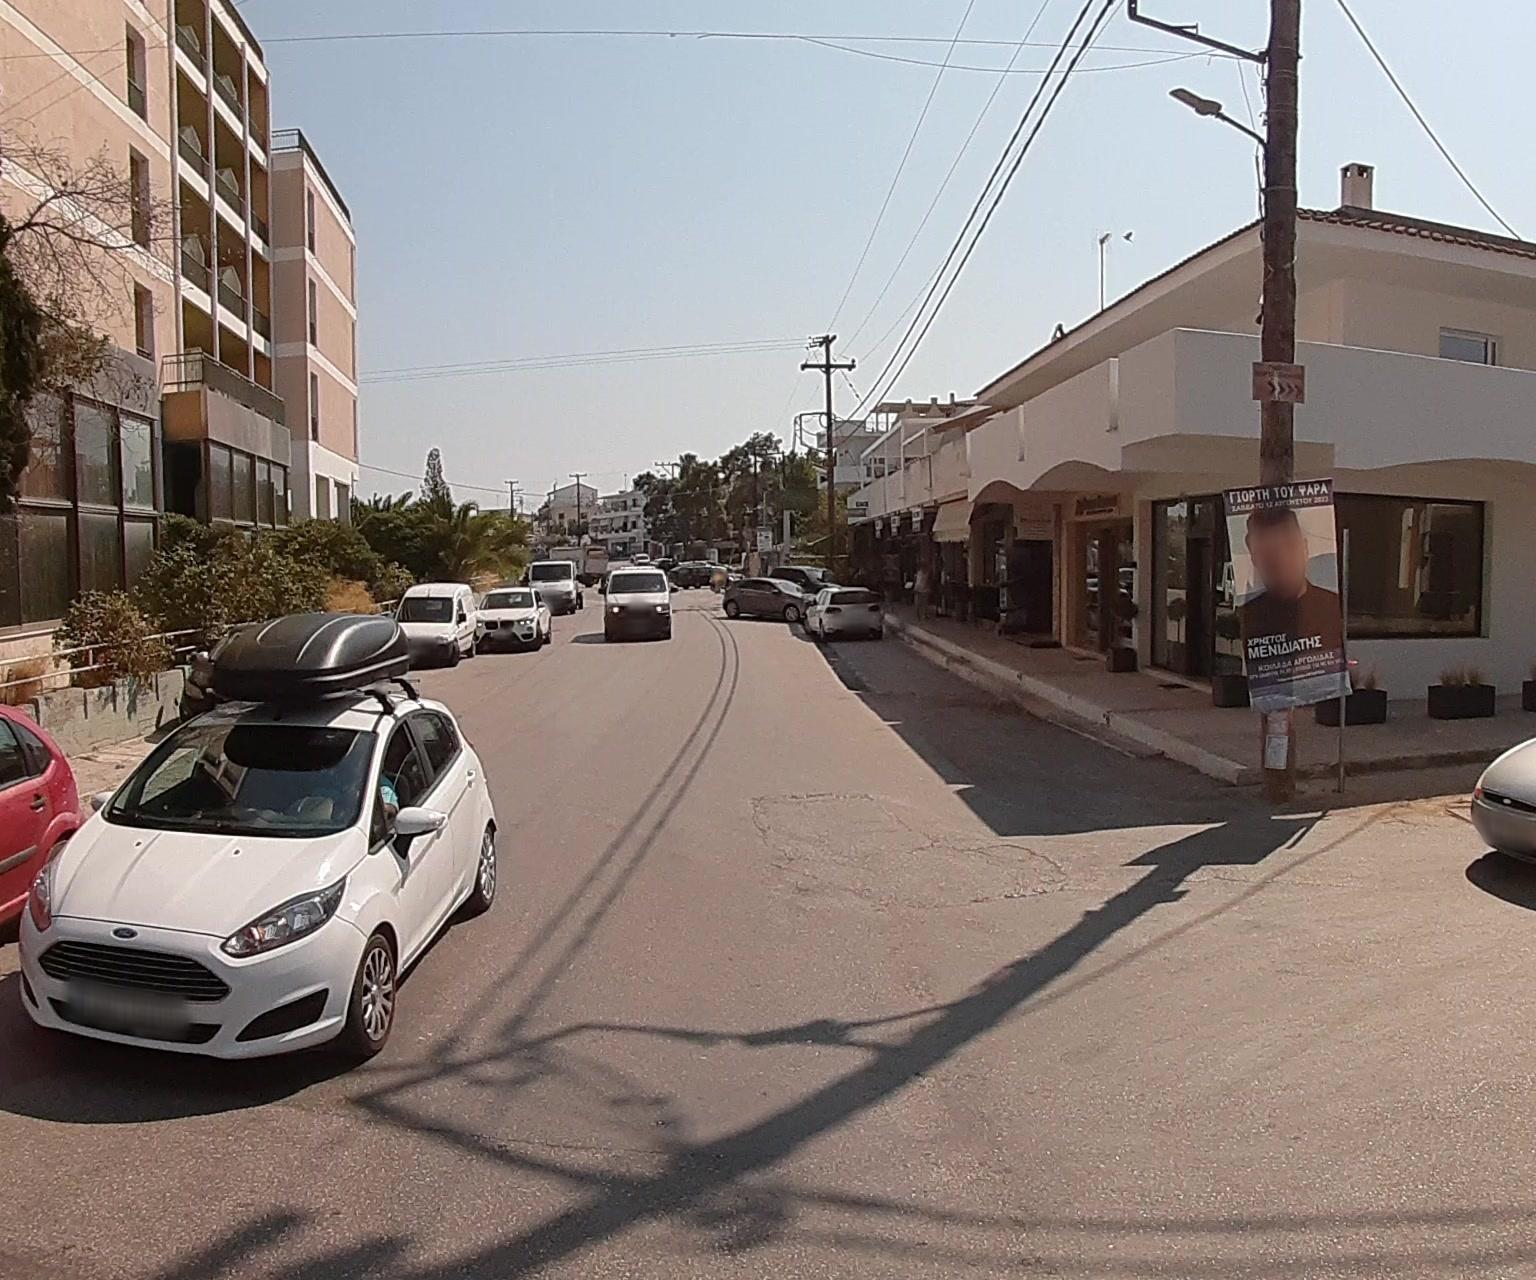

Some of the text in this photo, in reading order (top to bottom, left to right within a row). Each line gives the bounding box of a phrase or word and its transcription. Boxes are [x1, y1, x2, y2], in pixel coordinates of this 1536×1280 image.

[1229, 482, 1328, 504] ΓΙΟΡΤΗ ΤΟΥ ΨΑΡΑ
[1247, 633, 1287, 647] ΧΡΗΣΤΟΣ
[1248, 635, 1323, 660] ΜΕΝΙΔΙΑΤΗΣ
